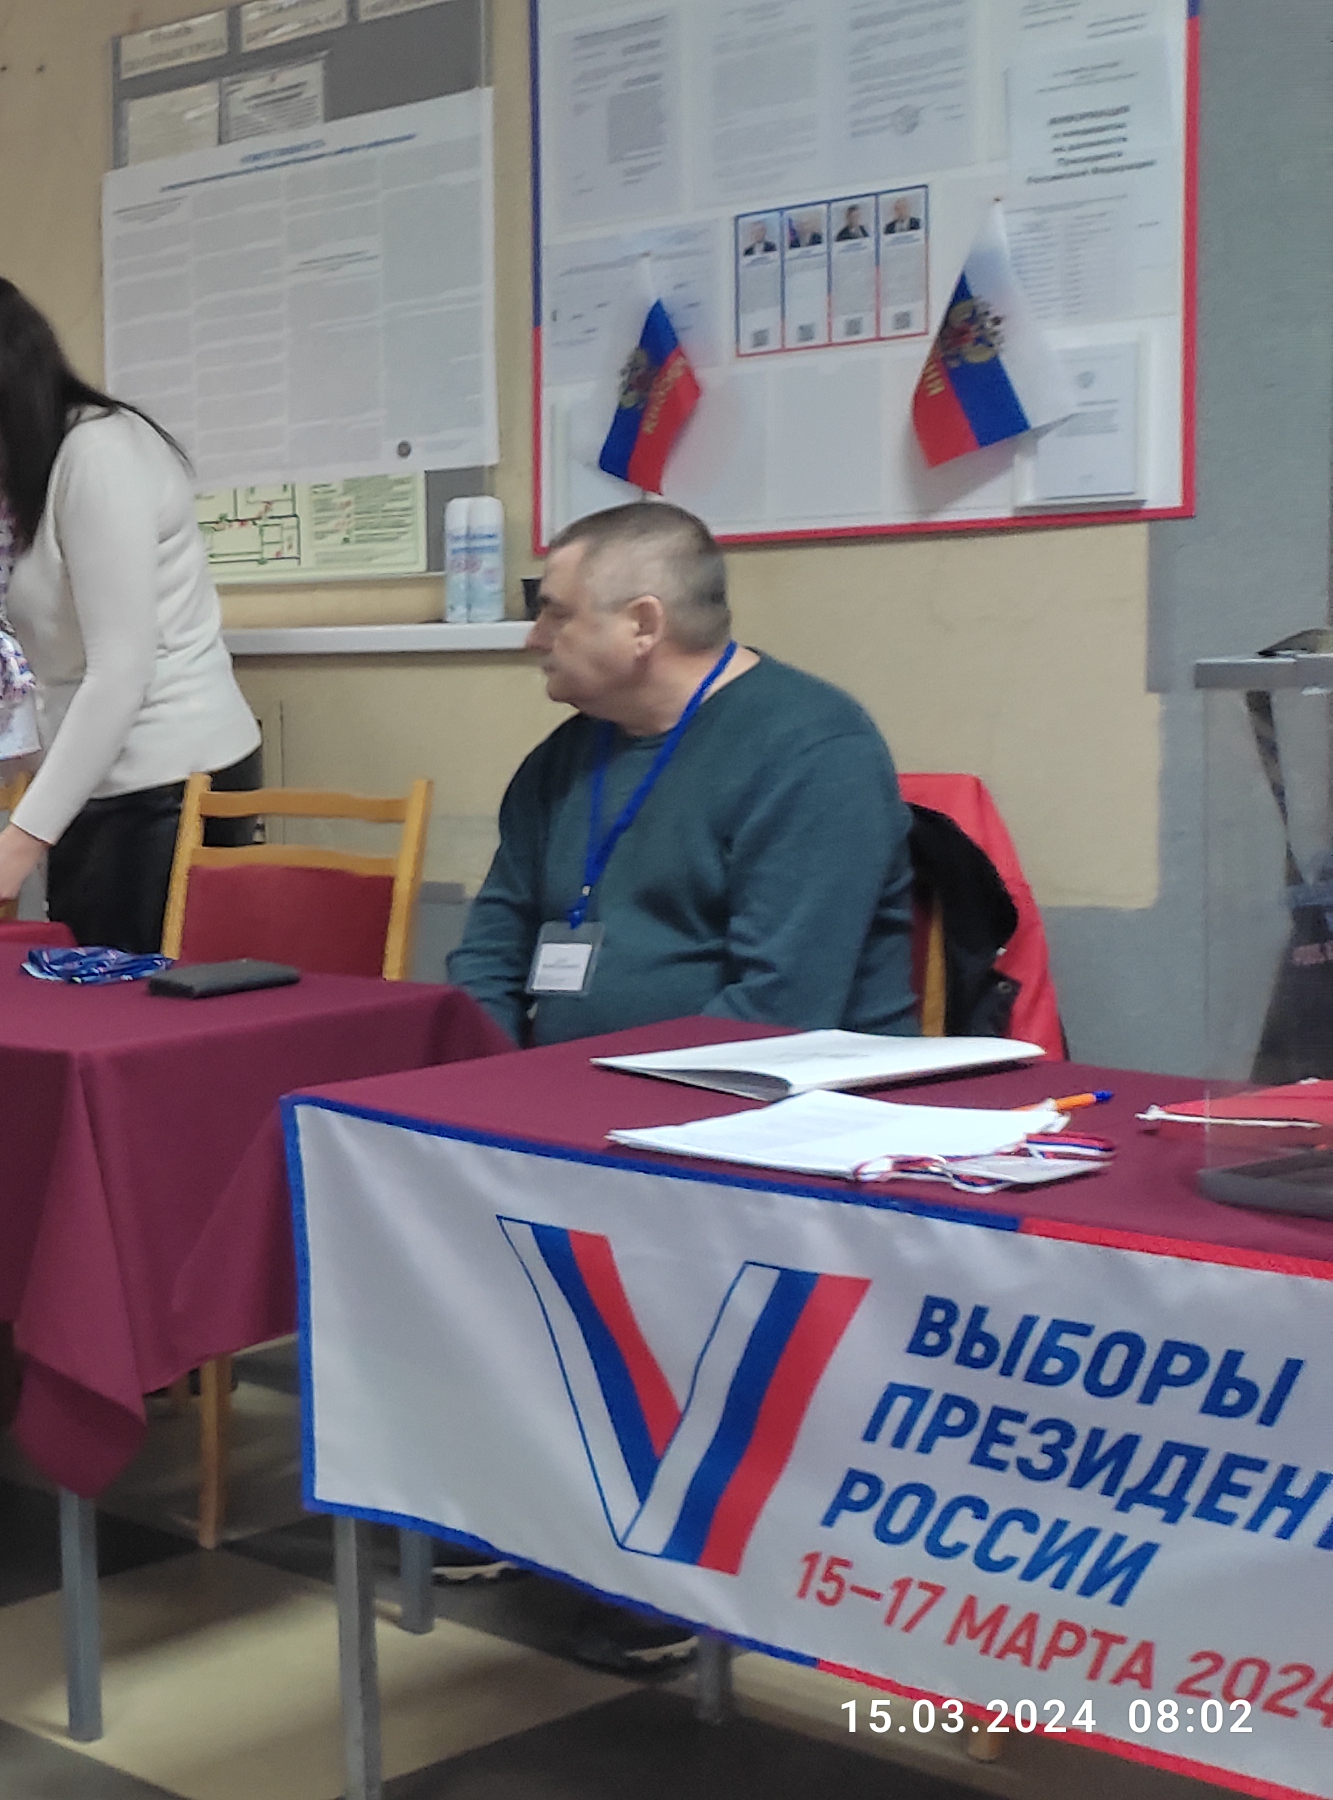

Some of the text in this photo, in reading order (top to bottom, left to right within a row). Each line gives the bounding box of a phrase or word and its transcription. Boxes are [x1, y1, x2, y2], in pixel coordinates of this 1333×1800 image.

[905, 1295, 1306, 1427] ВЫБОРЫ
[861, 1382, 1333, 1550] ПРЕЗИДЕН
[821, 1467, 1161, 1607] РОССИИ
[943, 1594, 1155, 1690] МАРТА
